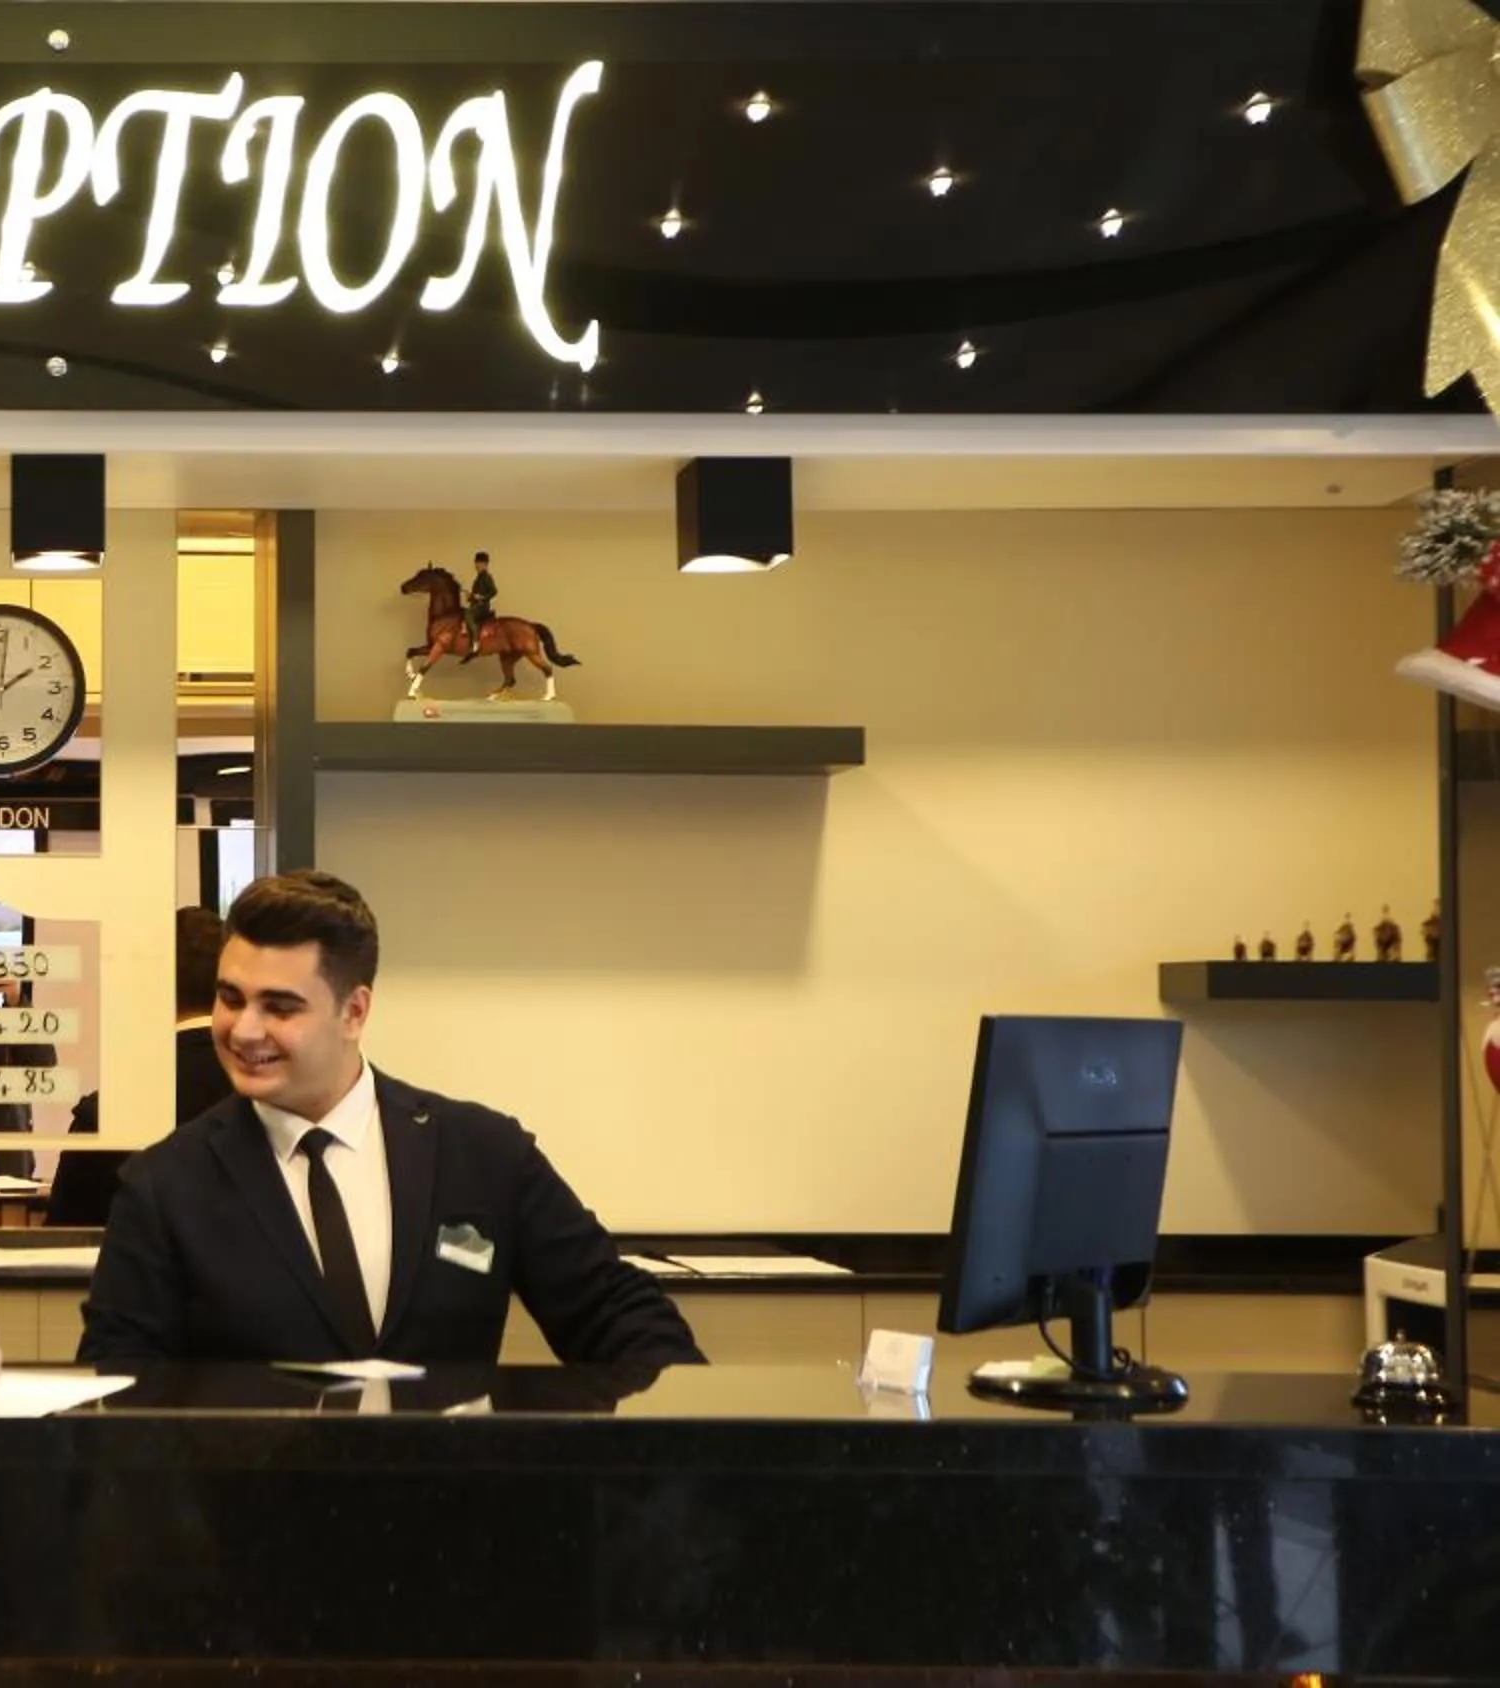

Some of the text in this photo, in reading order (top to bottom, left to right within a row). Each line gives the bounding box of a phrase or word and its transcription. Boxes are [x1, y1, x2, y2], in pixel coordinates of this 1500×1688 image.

[38, 655, 52, 669] 2
[47, 681, 61, 695] 3
[41, 708, 54, 721] 4
[22, 727, 37, 742] 5
